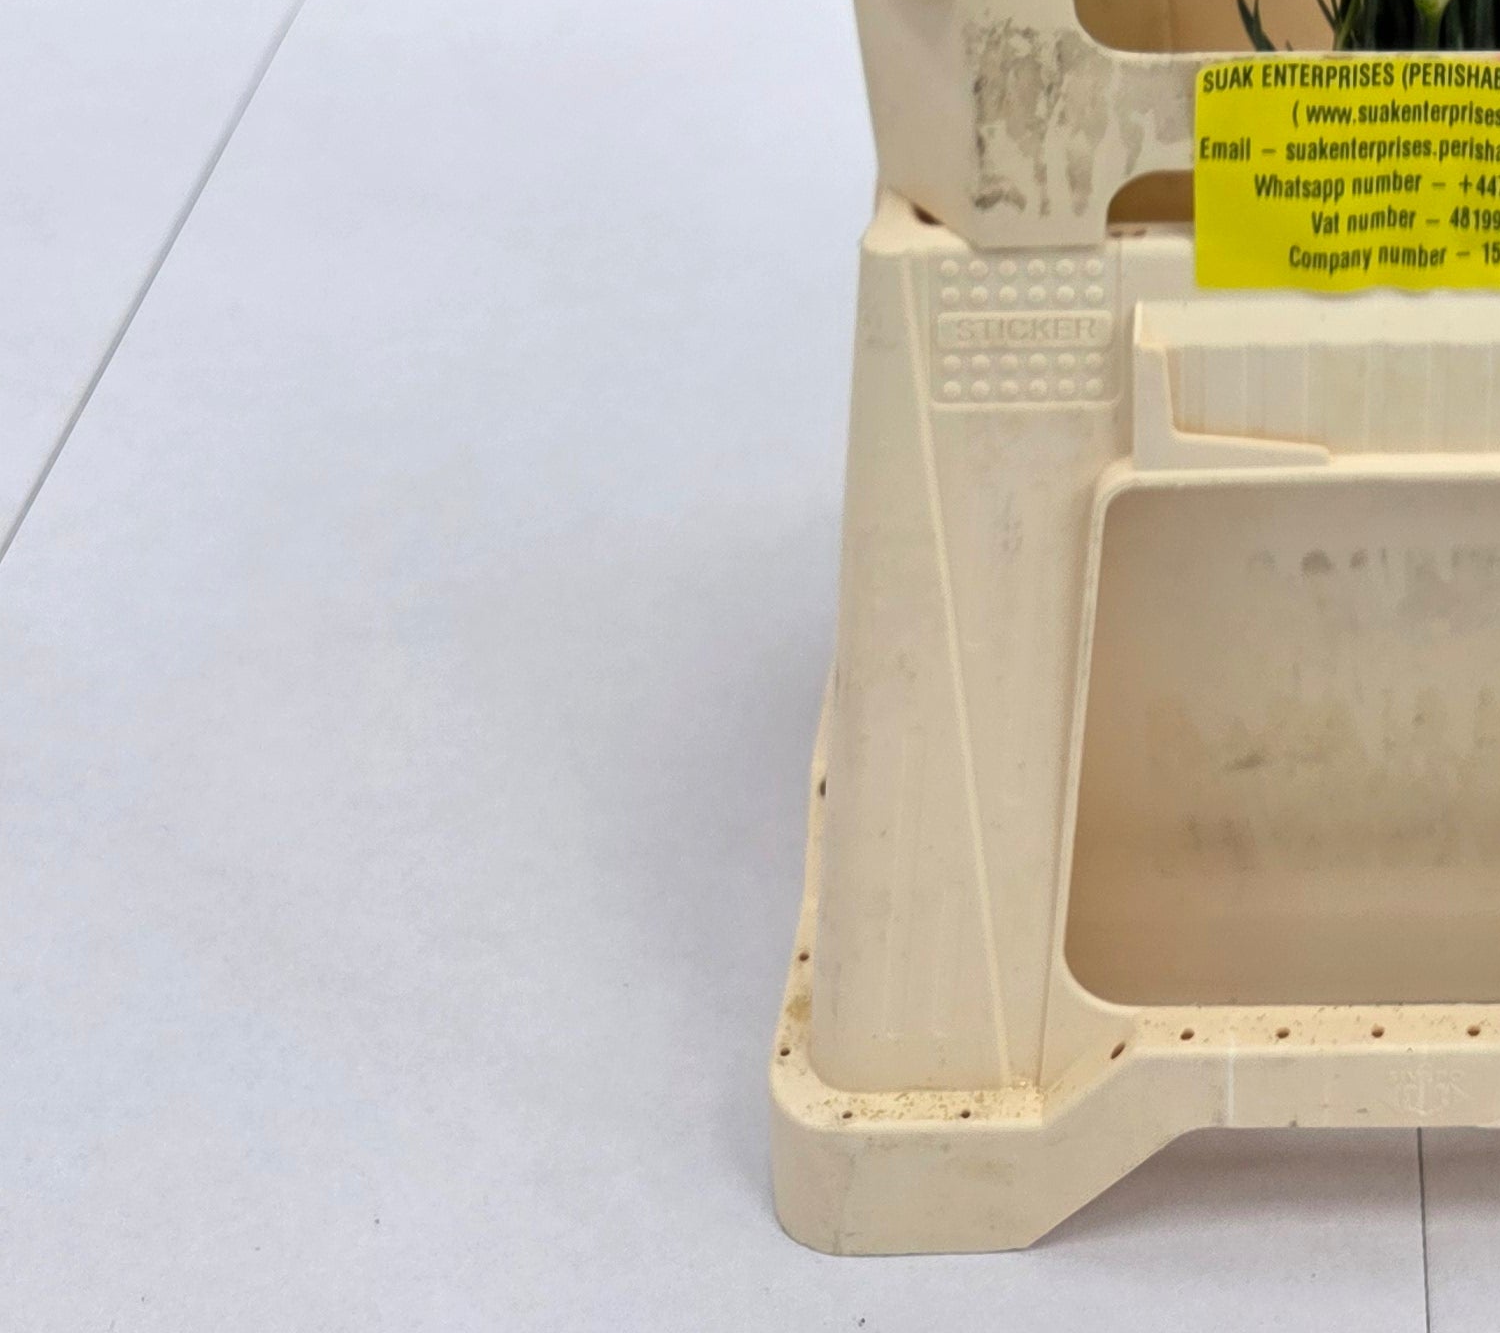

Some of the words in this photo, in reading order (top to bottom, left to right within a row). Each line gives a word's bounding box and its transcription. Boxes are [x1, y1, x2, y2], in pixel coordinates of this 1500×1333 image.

[1203, 65, 1254, 93] SUAK
[1261, 62, 1395, 90] ENTERPRISES
[1199, 137, 1251, 161] Email
[1254, 174, 1345, 204] Whatsapp
[1351, 170, 1422, 195] number
[1311, 211, 1340, 235] Vat
[1347, 207, 1416, 233] number
[1288, 244, 1372, 276] Company
[1378, 244, 1447, 268] number
[957, 318, 1097, 341] STICKER
